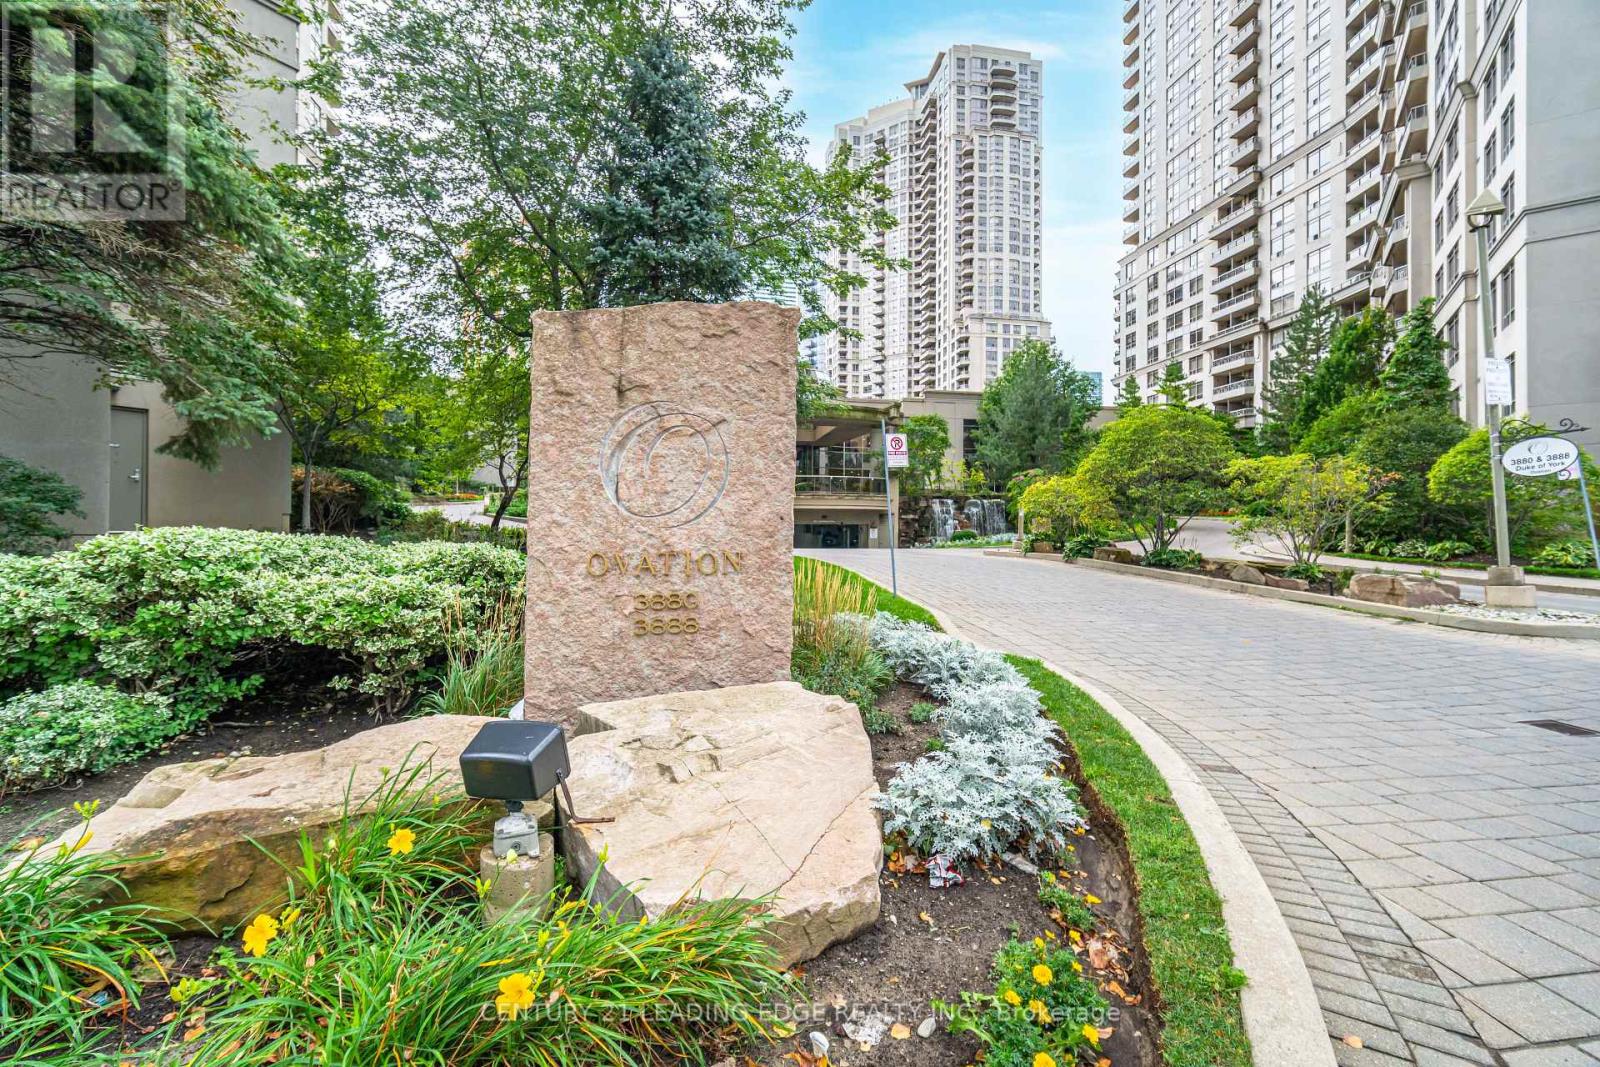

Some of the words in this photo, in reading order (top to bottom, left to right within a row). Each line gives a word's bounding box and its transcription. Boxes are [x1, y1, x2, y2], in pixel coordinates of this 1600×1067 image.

[1511, 456, 1534, 466] 3880
[1536, 455, 1543, 463] &
[1546, 452, 1570, 462] 3888
[1515, 464, 1536, 472] Duke
[1548, 461, 1565, 469] York
[586, 549, 743, 577] OVATION
[634, 616, 699, 636] 3888
